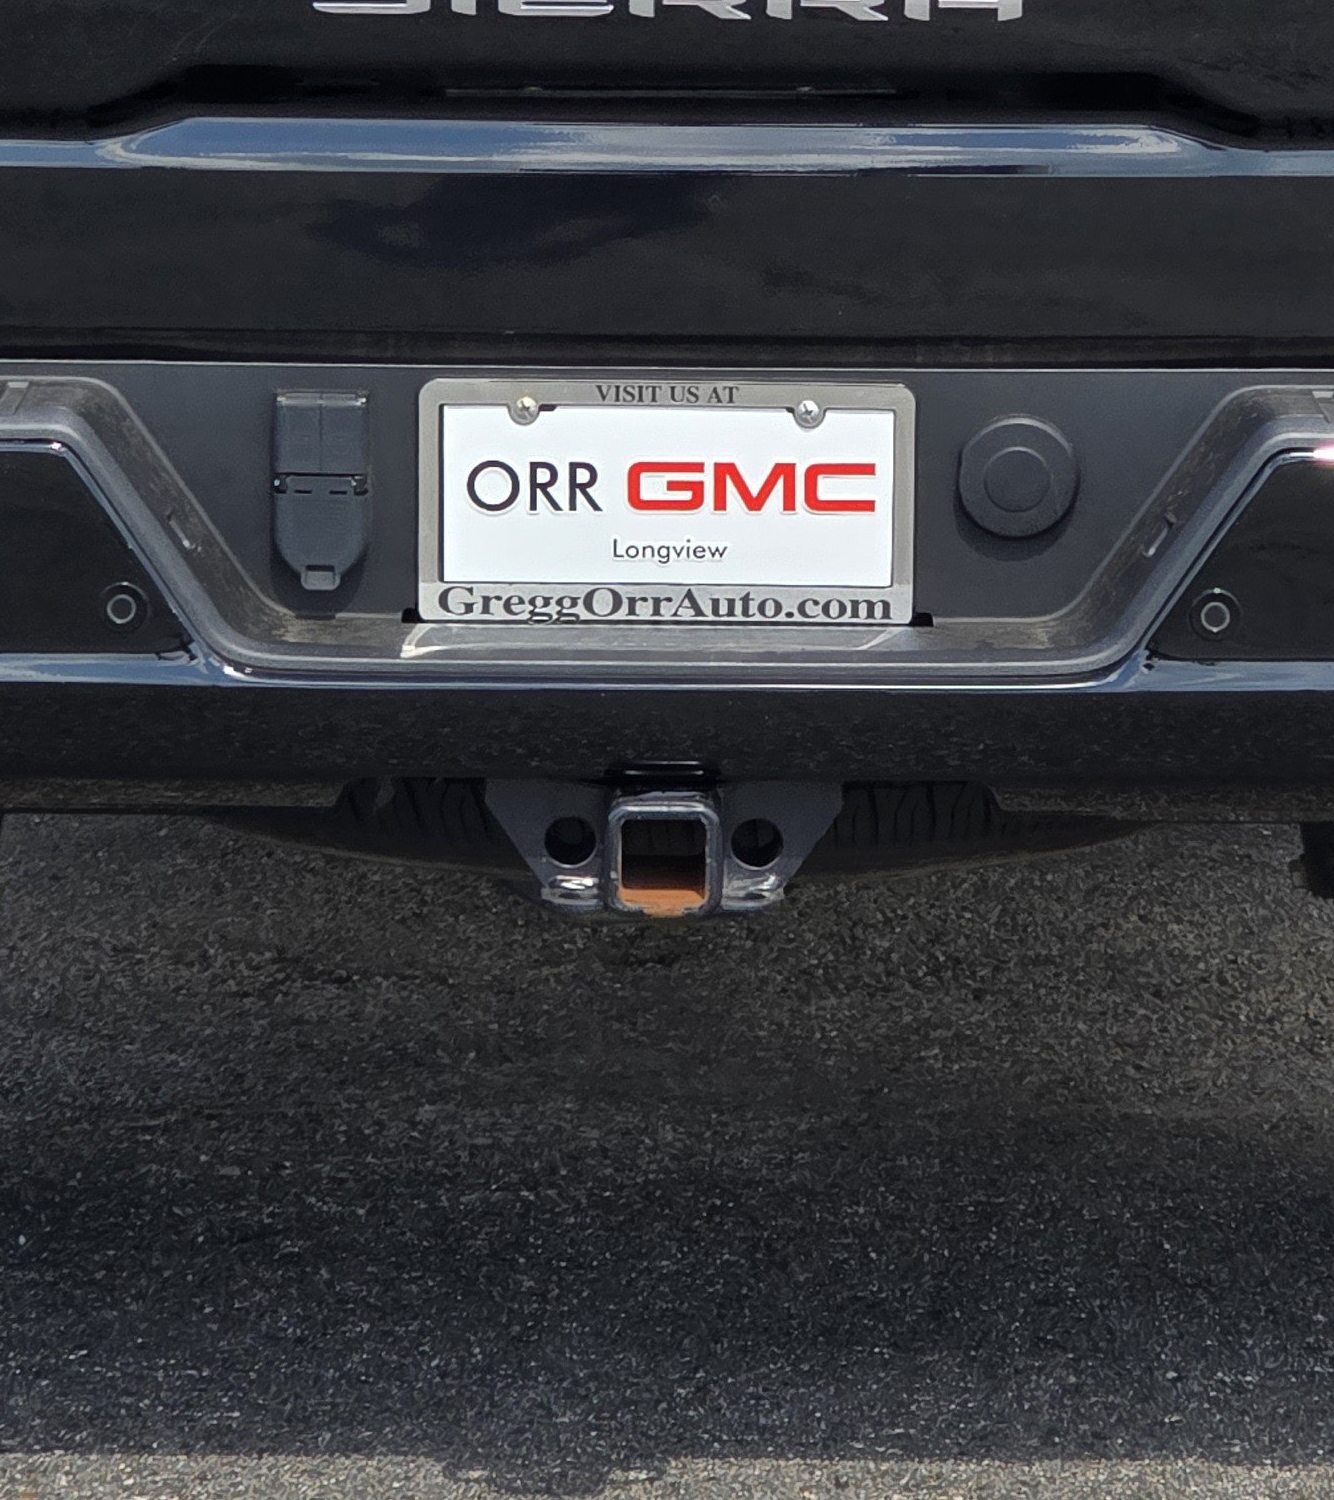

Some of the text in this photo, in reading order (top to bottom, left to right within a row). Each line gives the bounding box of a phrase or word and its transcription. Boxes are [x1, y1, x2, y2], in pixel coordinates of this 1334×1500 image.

[595, 384, 740, 405] VISIT US AT
[466, 460, 877, 513] ORR GMC
[612, 537, 729, 566] Longview
[438, 586, 894, 626] GreggOrrAuto.com
